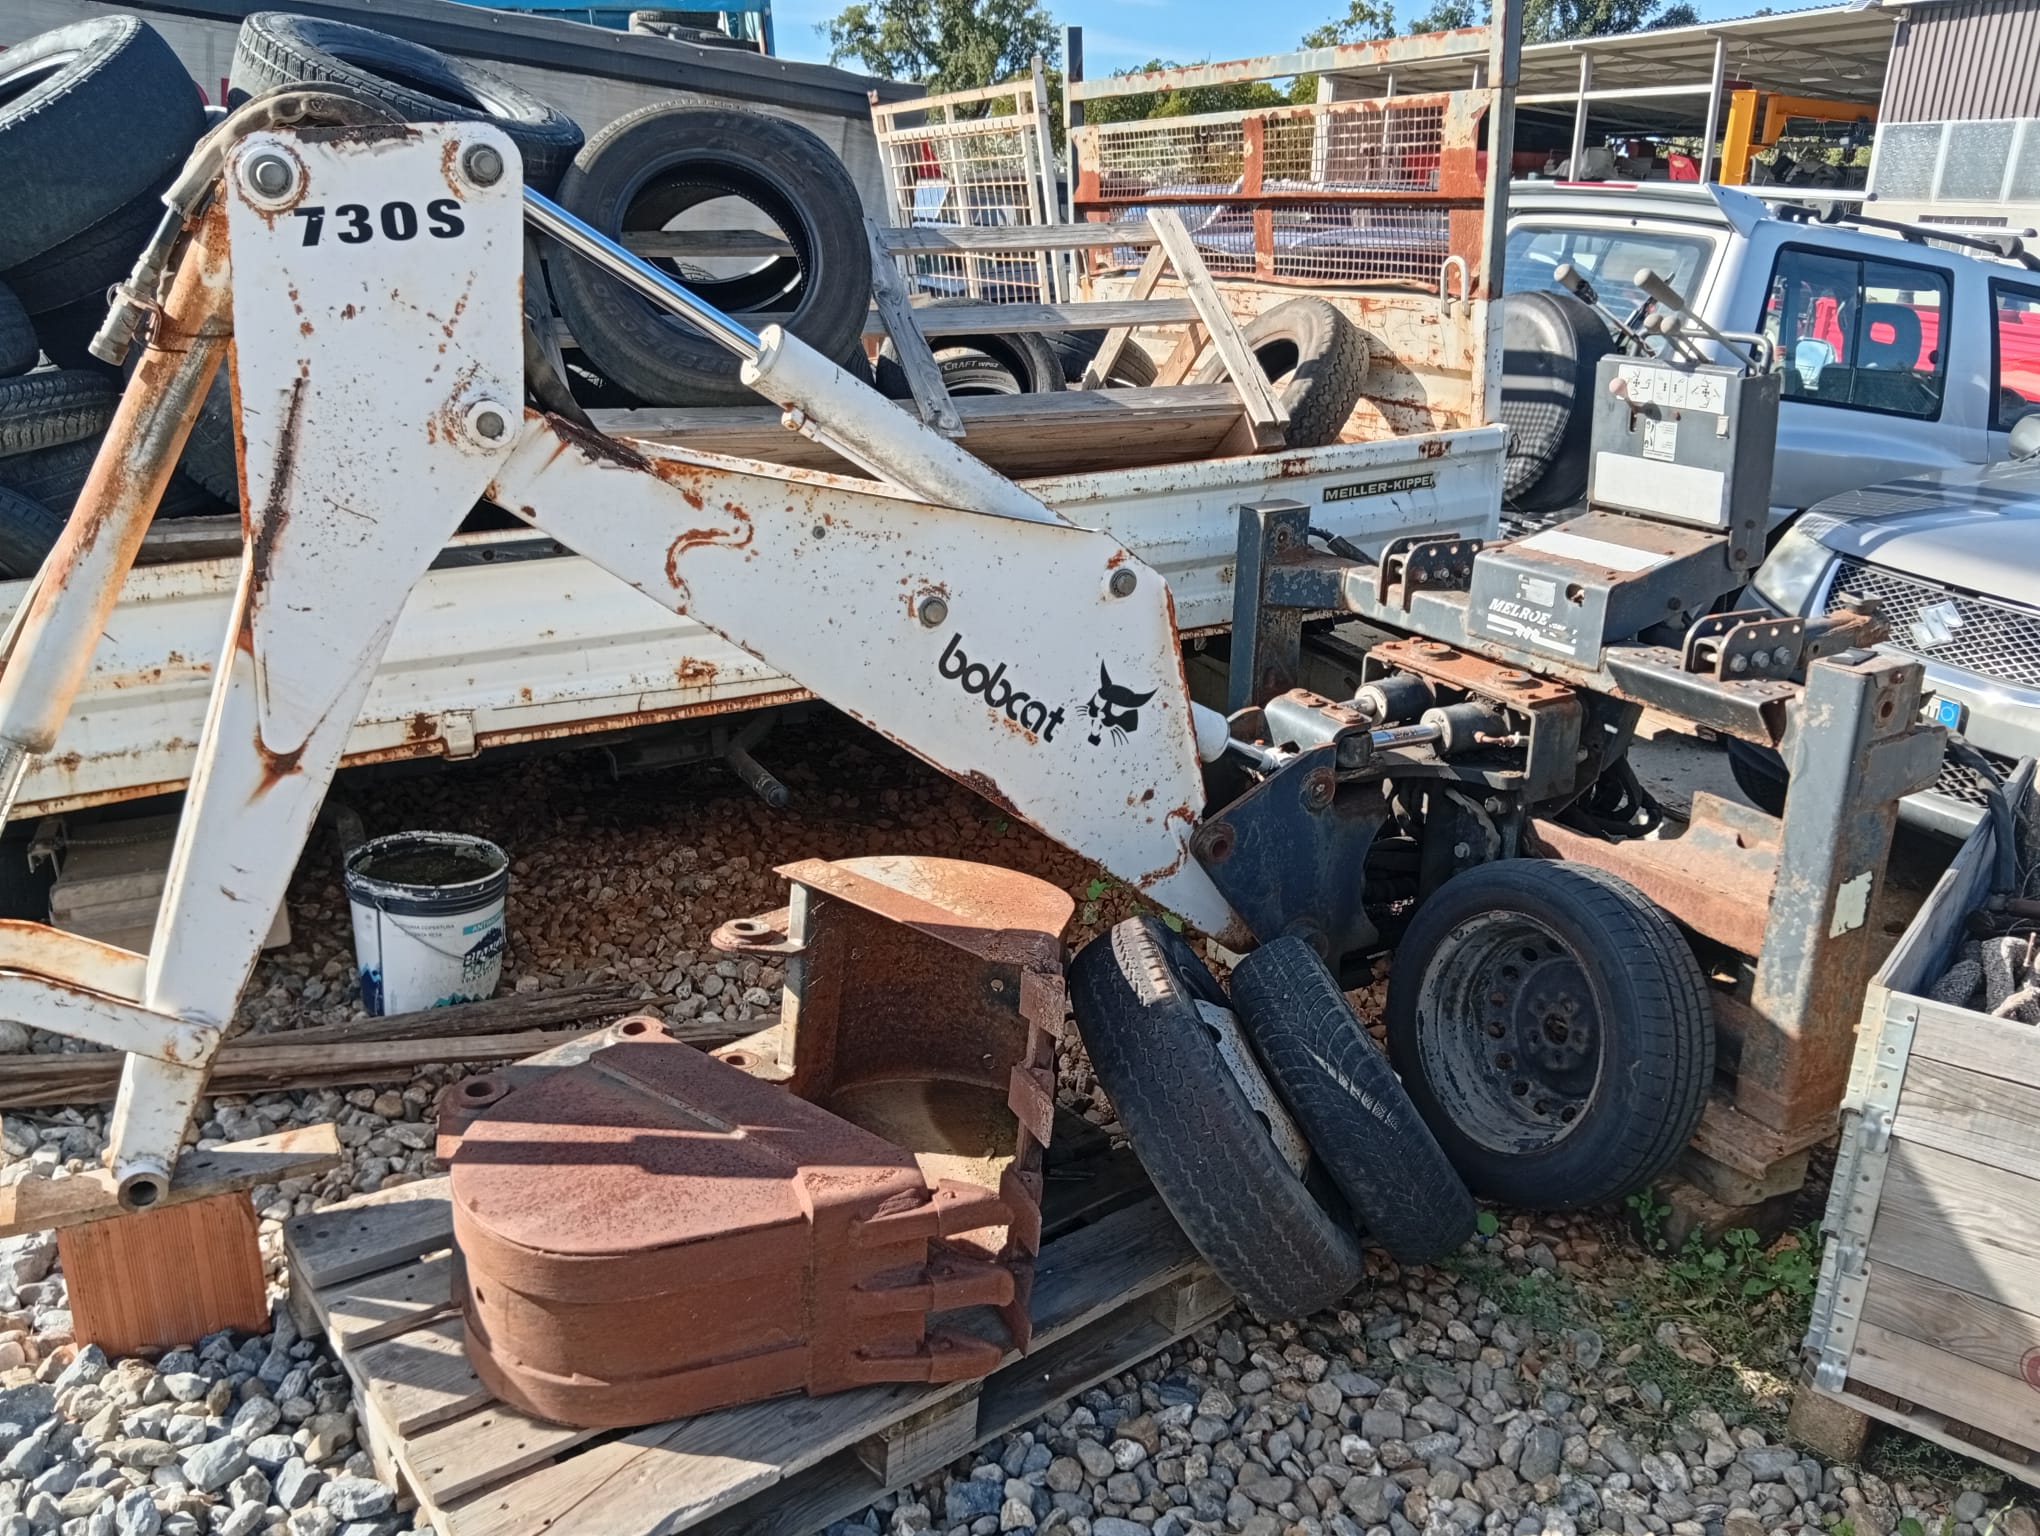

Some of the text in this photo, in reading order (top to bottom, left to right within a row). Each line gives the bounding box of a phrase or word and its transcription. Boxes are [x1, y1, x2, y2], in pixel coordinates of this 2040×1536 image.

[294, 198, 466, 247] 730S
[1487, 598, 1553, 626] MELROE
[938, 632, 1066, 744] bobcat
